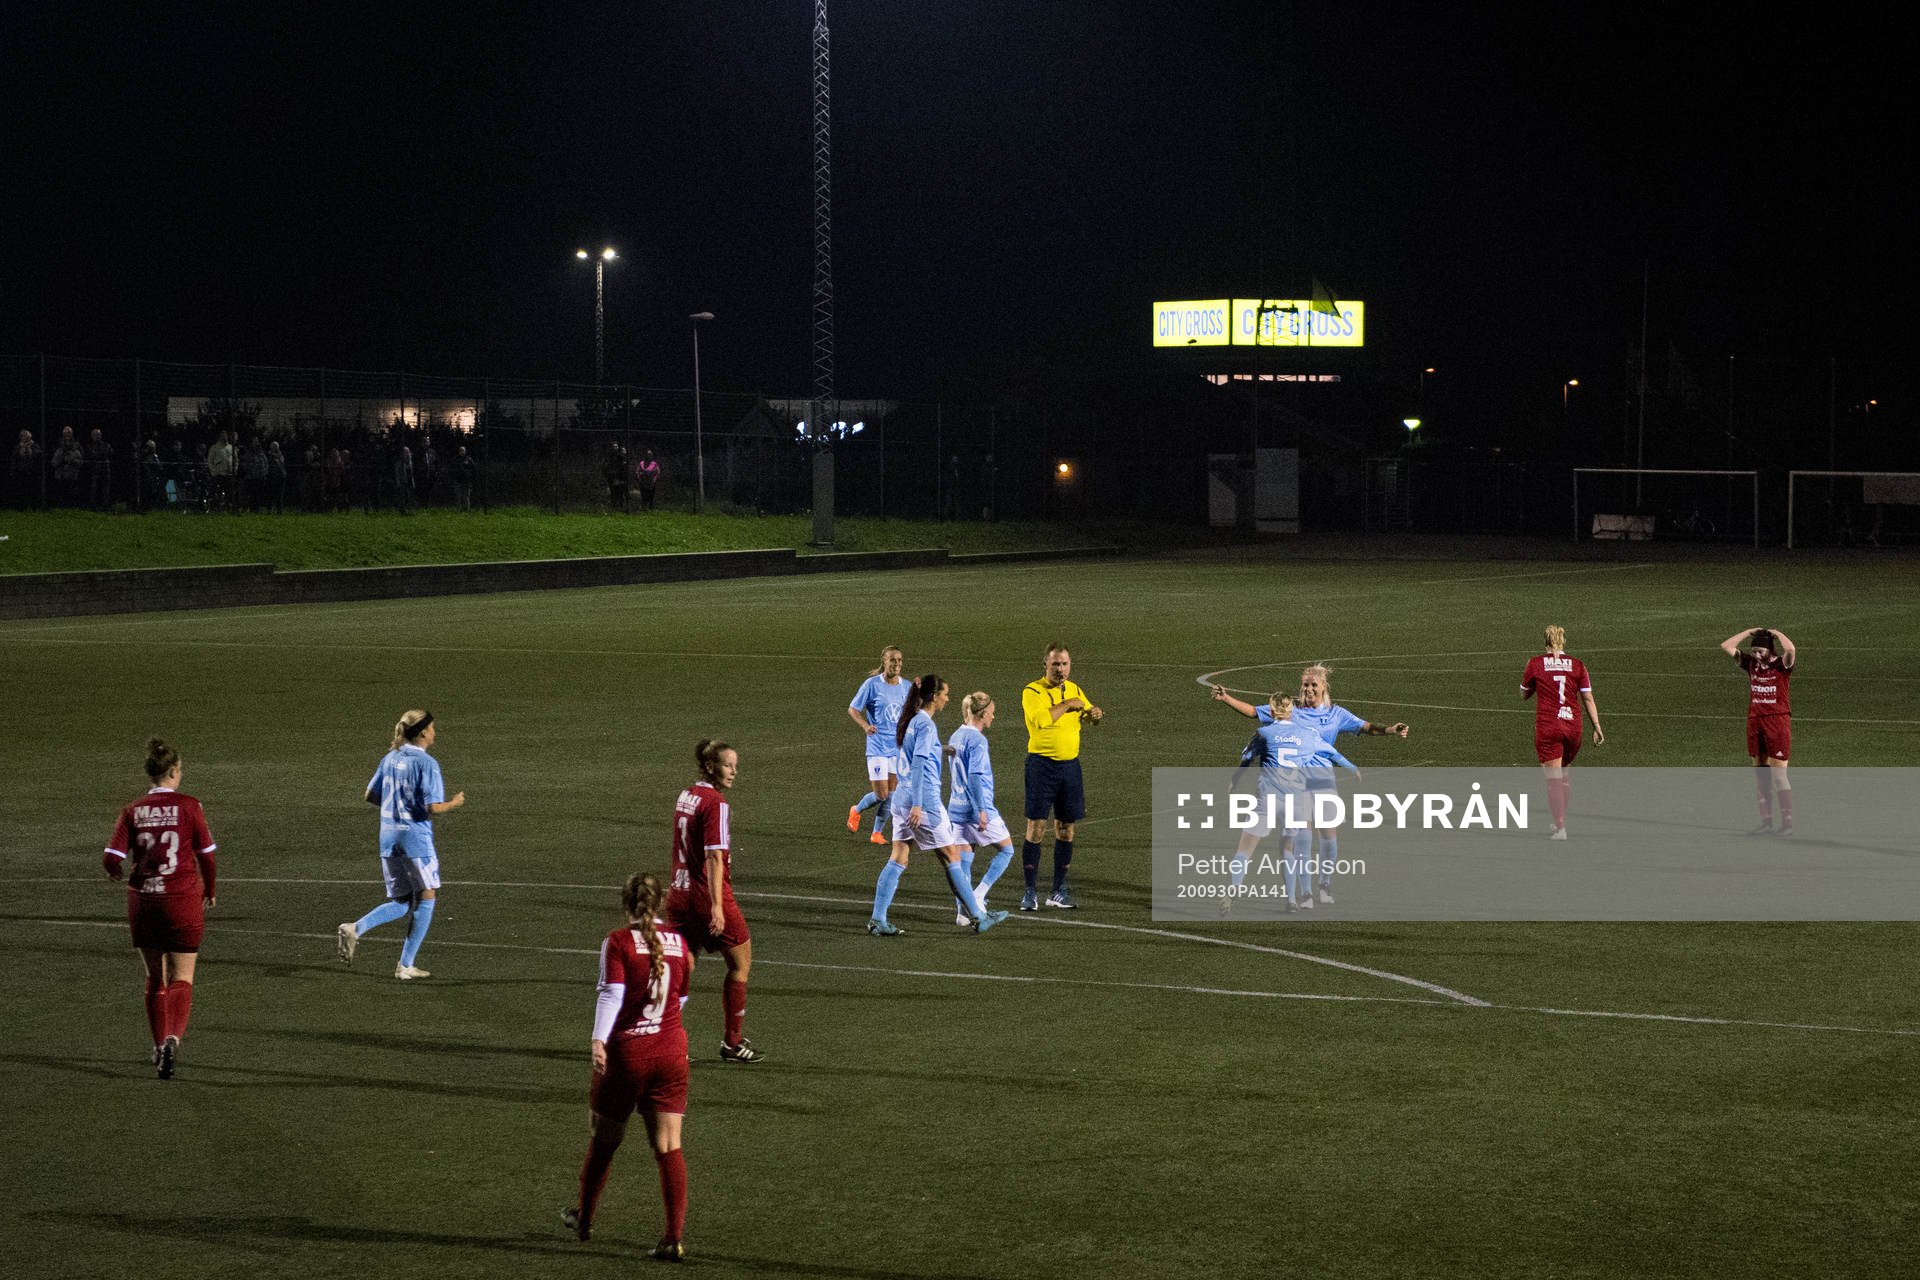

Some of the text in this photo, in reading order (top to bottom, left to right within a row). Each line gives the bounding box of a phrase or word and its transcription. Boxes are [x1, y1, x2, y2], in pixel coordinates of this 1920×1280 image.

[1159, 310, 1223, 337] CITY GROSS
[1242, 308, 1285, 336] CTY
[1553, 675, 1567, 705] 7
[133, 805, 179, 819] MAXI
